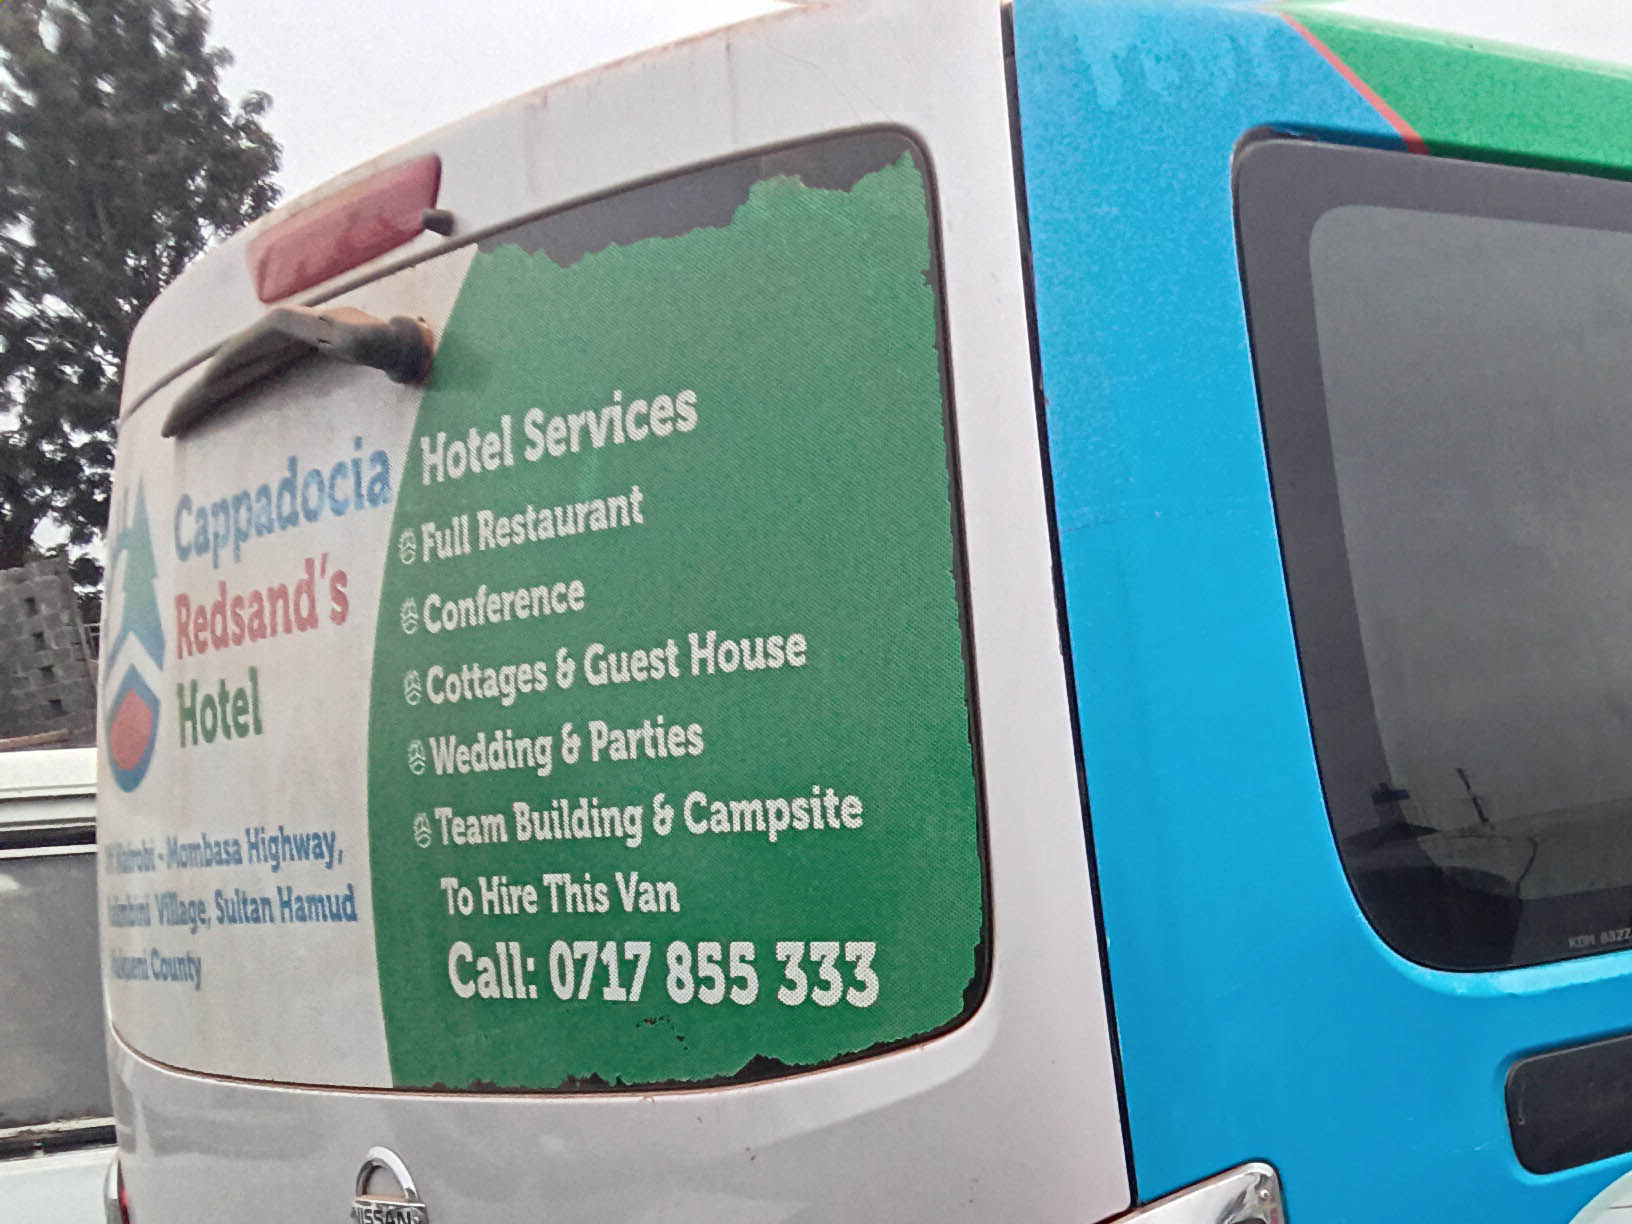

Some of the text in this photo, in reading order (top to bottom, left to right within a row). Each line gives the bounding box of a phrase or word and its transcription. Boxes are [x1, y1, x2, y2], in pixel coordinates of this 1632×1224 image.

[421, 389, 698, 485] Hotel Services
[174, 436, 392, 568] Cappadocia
[422, 485, 644, 562] Full Restaurant
[174, 553, 349, 660] Redsand's
[423, 580, 585, 633] Conference
[427, 630, 806, 706] Cottages & Guest House
[176, 667, 263, 747] Hotel
[429, 715, 704, 776] Wedding & Parties
[245, 825, 343, 873] Highway,
[435, 785, 863, 847] Team Building & Campsite
[214, 888, 274, 924] Sultan
[277, 883, 357, 923] Hamud
[441, 872, 680, 915] To Hire This Van
[448, 940, 879, 1007] Call: 0717 855 333
